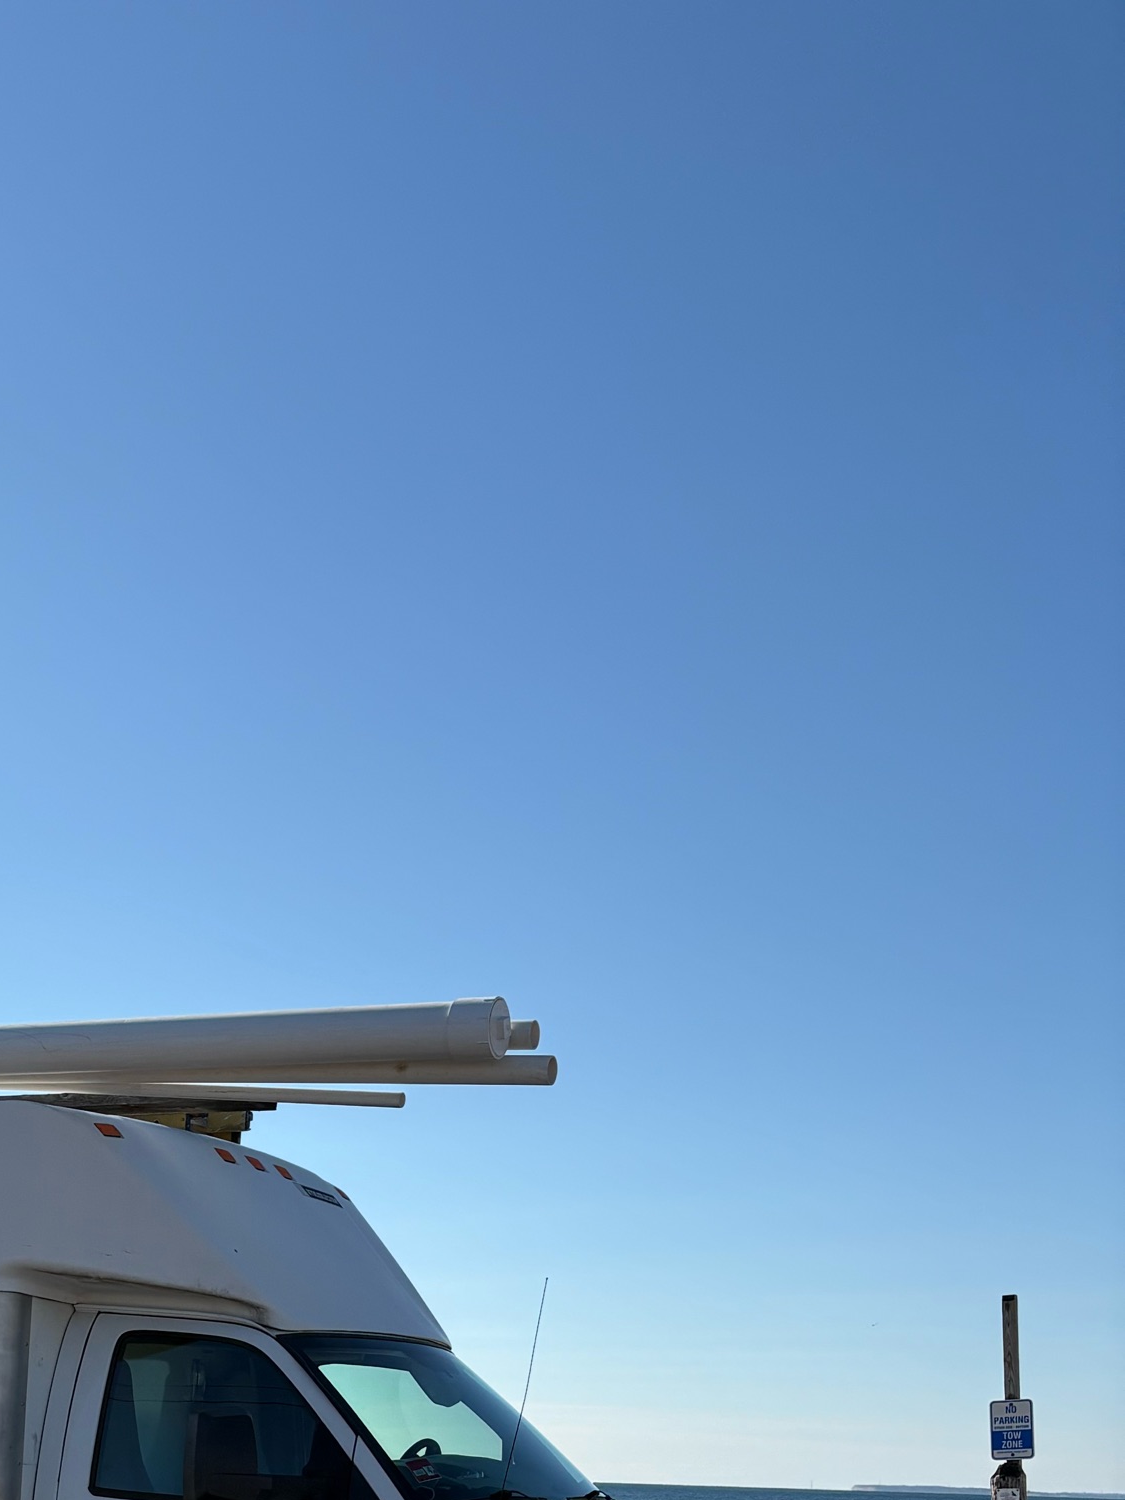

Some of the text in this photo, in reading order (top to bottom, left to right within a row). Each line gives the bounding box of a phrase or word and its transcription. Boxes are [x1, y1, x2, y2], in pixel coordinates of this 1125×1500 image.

[1005, 1405, 1016, 1413] NO
[994, 1415, 1029, 1424] PARKING
[1002, 1431, 1021, 1439] TOW
[1001, 1440, 1023, 1449] ZONE
